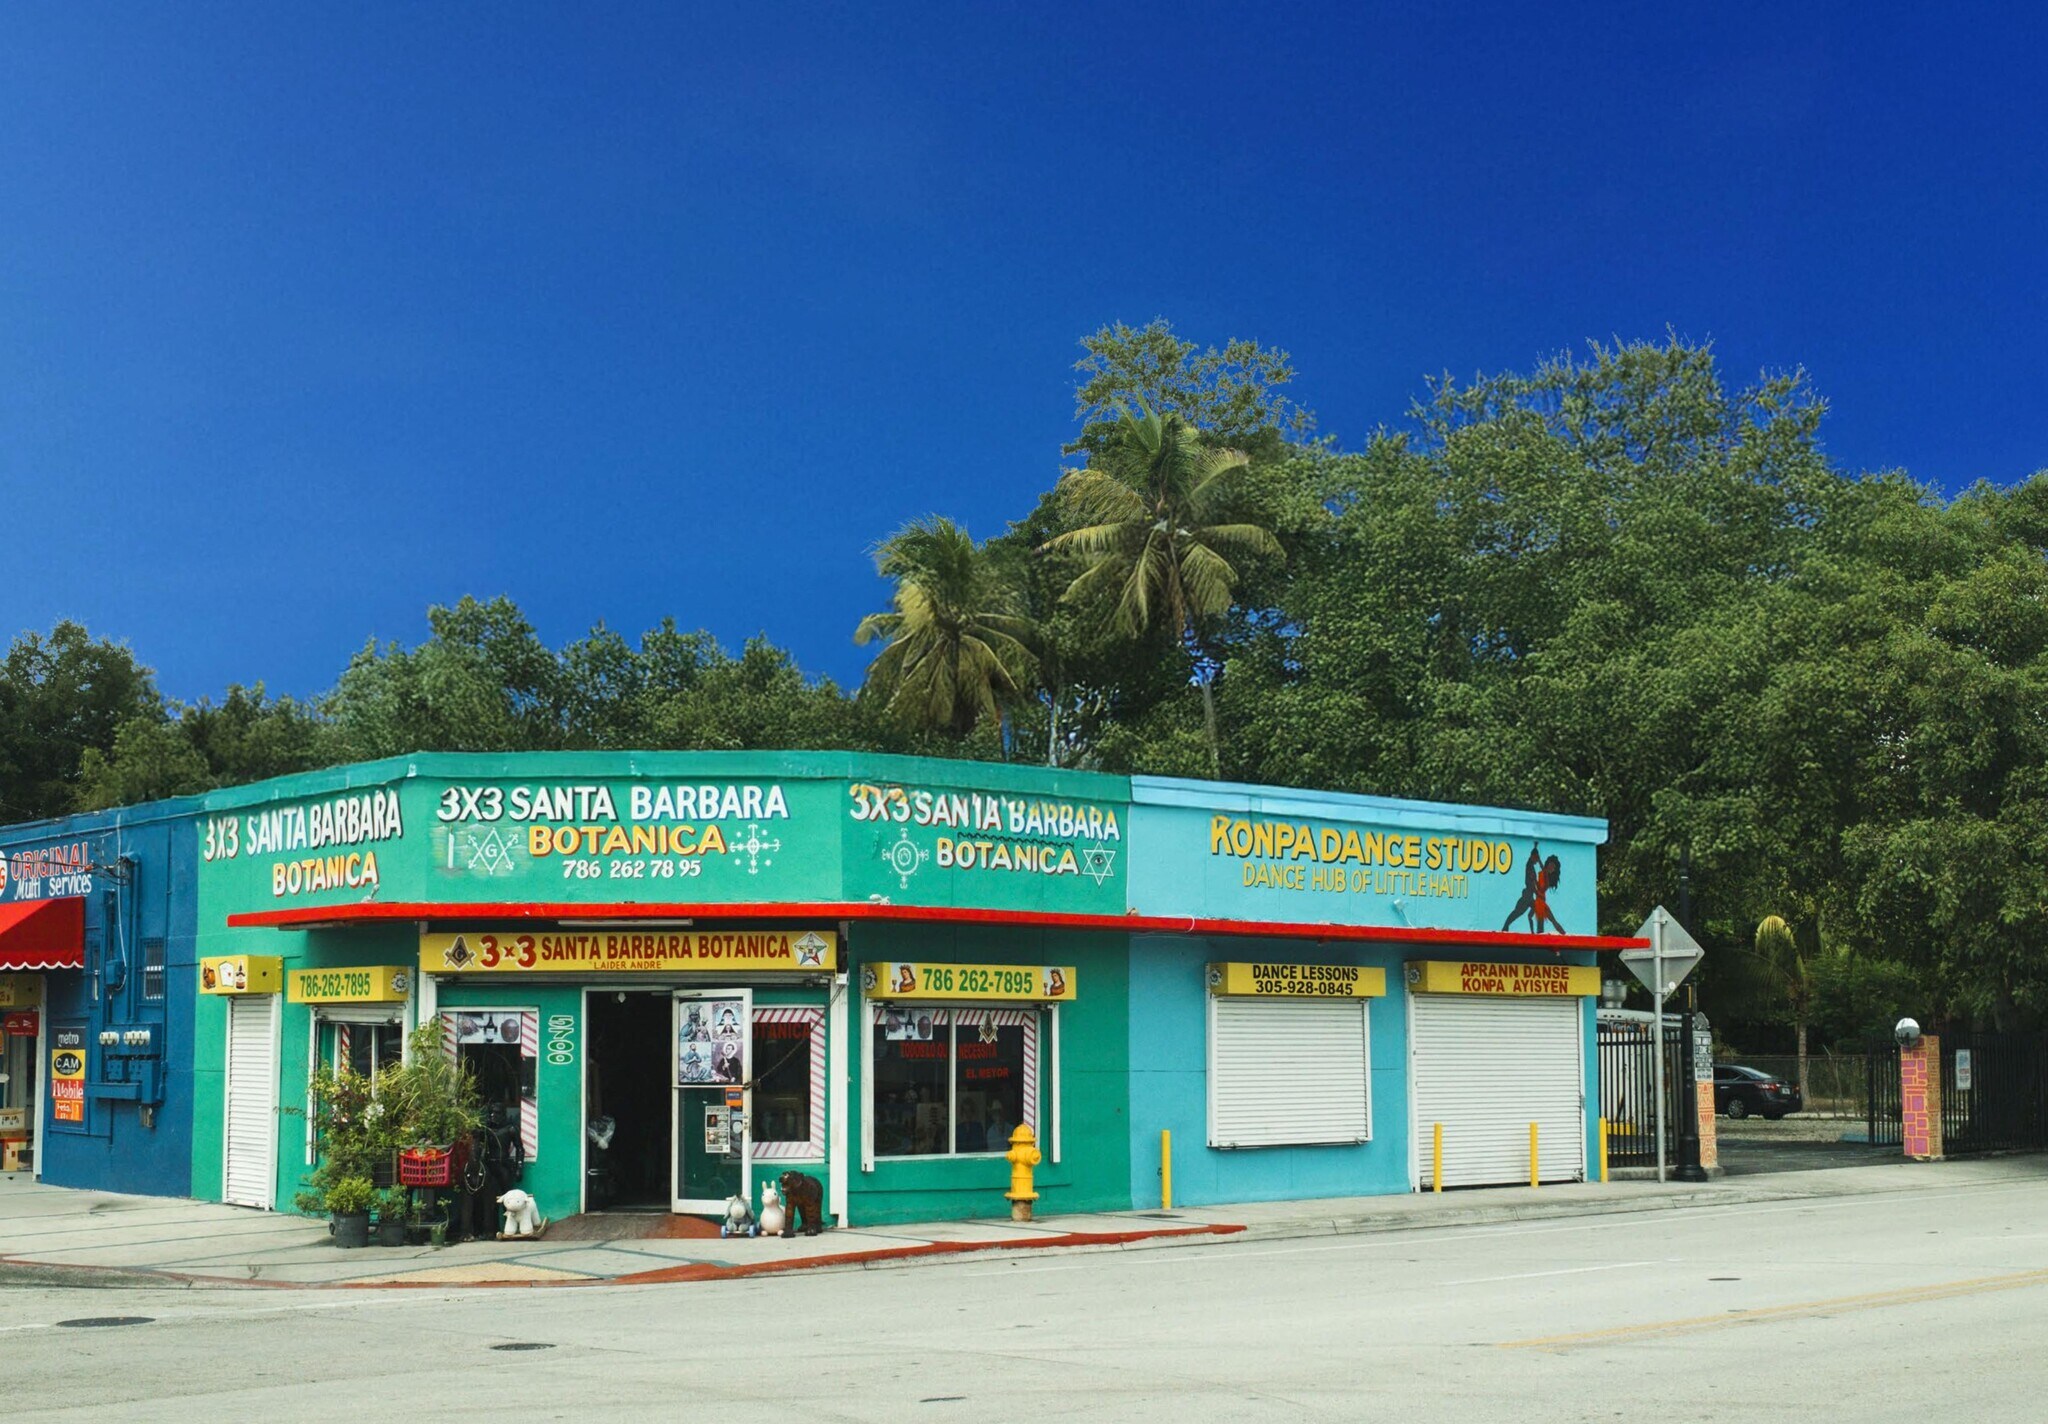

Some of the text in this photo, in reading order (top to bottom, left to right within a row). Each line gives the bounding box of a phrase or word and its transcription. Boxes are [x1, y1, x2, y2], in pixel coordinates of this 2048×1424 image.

[436, 785, 791, 822] 3X3 SANTA BARBARA
[849, 784, 911, 823] 3X3
[1008, 799, 1121, 842] BARBARA
[203, 789, 403, 863] 3X3 SANTA BARBARA
[528, 824, 728, 857] BOTANICA
[11, 841, 88, 881] ORIGINAL
[937, 837, 1080, 876] BOTANICA
[1321, 827, 1422, 869] DANCE
[1425, 835, 1513, 874] STUDIO
[272, 850, 379, 897] BOTANICA
[562, 859, 702, 879] 786 262 78 95
[1243, 861, 1469, 899] DANCE HUB OF LITTLE HAITI
[14, 872, 92, 900] Multi services
[541, 936, 601, 960] SANTA
[607, 935, 693, 960] BARBARA
[698, 935, 790, 958] BOTANICA
[300, 973, 370, 997] 786-262-7895
[923, 968, 1033, 994] 786 262-7895
[1253, 964, 1359, 981] DANCE LESSONS
[1461, 963, 1569, 980] APRANN DANSE
[1462, 978, 1568, 994] KONPA AYISYEN
[1256, 980, 1353, 995] 305-928-0845
[548, 1014, 574, 1064] 5700
[753, 1023, 808, 1039] OTANICA
